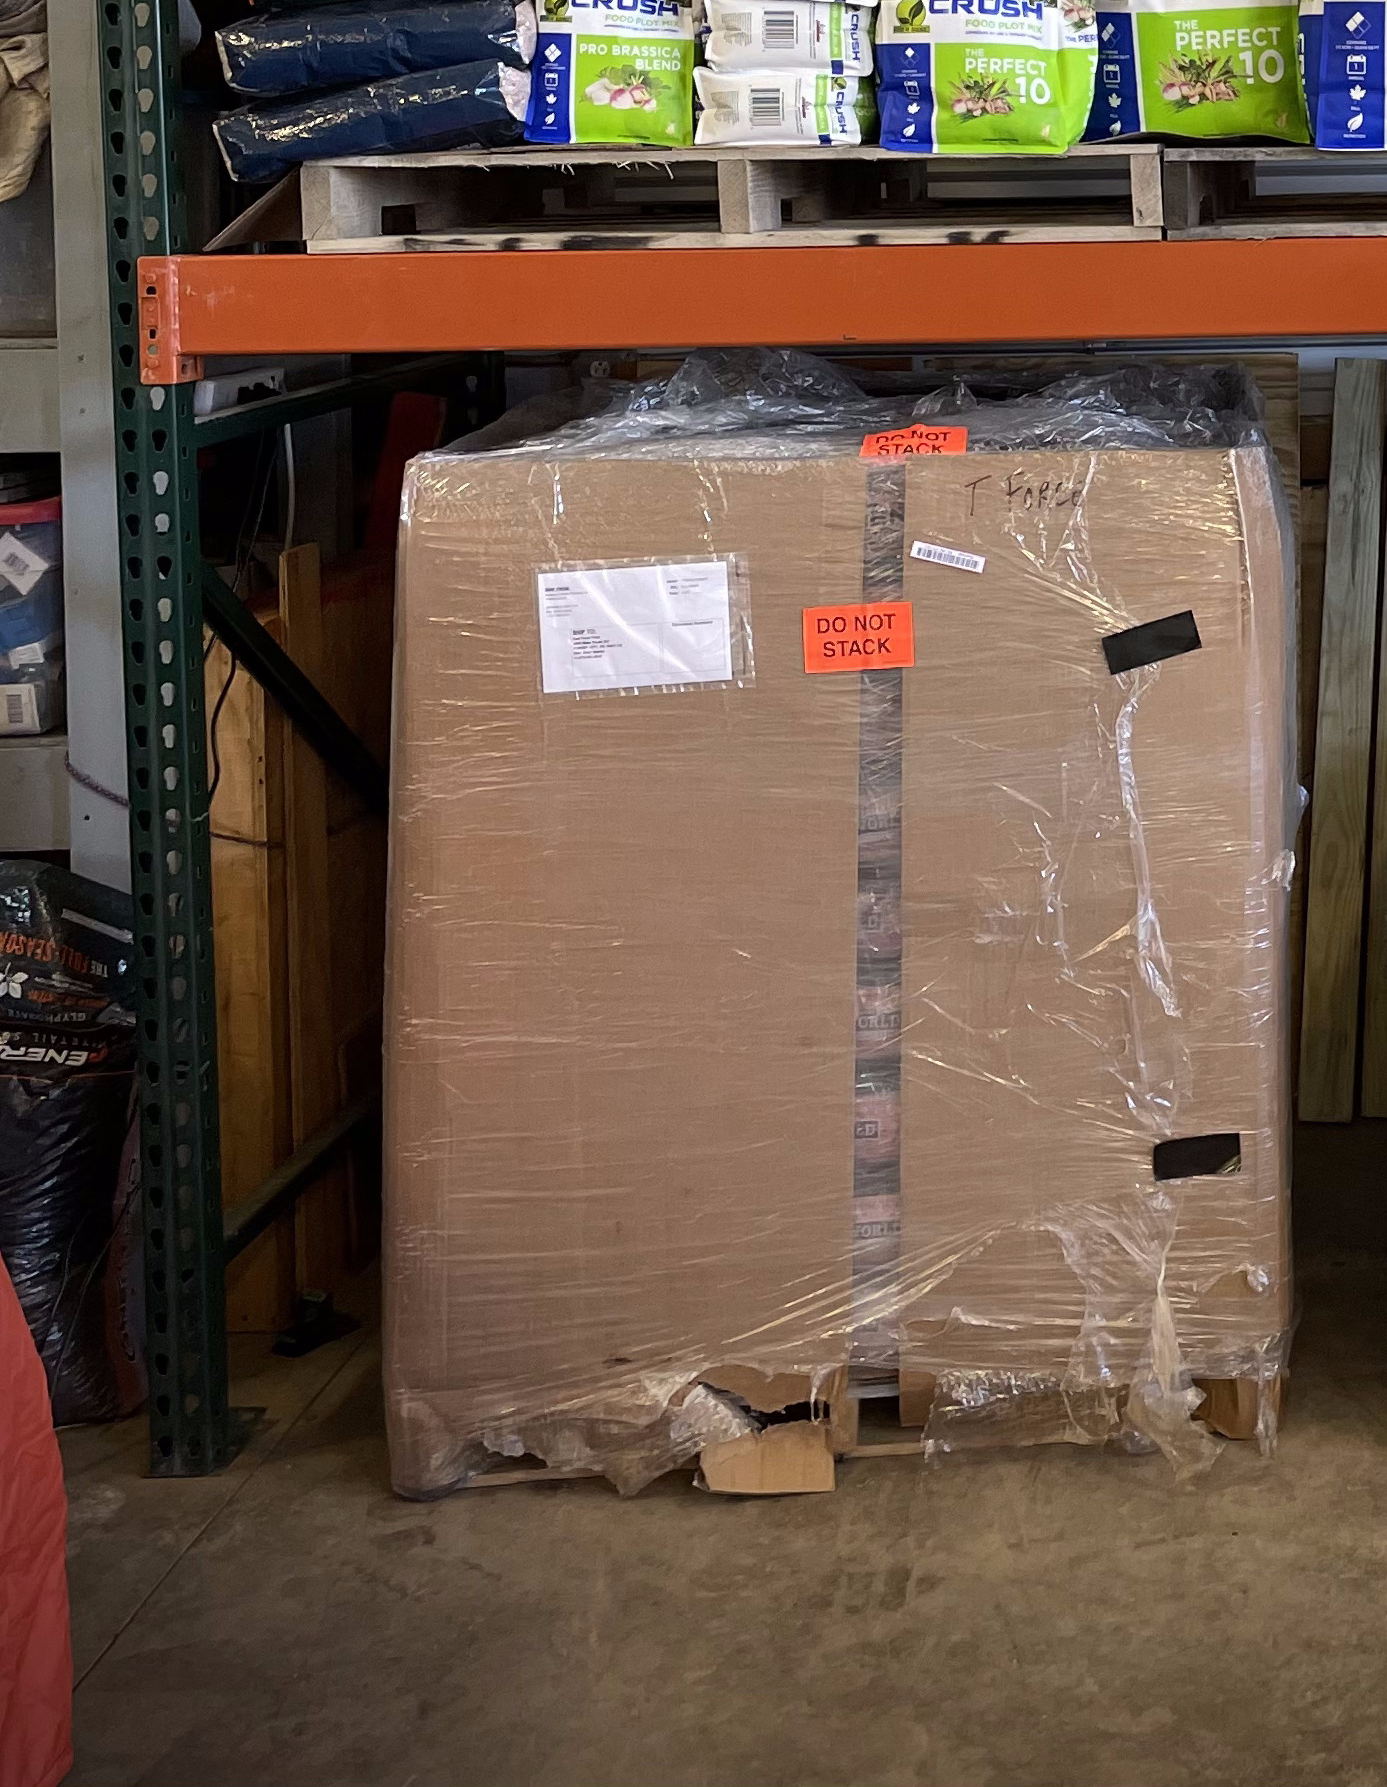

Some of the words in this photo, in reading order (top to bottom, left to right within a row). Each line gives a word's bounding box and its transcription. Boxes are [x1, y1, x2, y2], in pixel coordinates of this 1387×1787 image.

[604, 13, 635, 24] FOOD
[635, 17, 660, 27] PLOT
[662, 19, 680, 28] MIX
[965, 19, 996, 29] FOOD
[999, 20, 1024, 31] PLOT
[1027, 24, 1043, 34] MIX
[1174, 20, 1198, 31] THE
[850, 13, 861, 61] CRUSH
[1175, 27, 1281, 51] PERFECT
[579, 43, 608, 56] PRO
[611, 44, 681, 59] BRASSICA
[965, 48, 985, 58] THE
[635, 58, 681, 71] BLEND
[965, 57, 1048, 77] PERFECT
[1238, 49, 1285, 85] 10
[1015, 76, 1051, 105] 10
[835, 91, 848, 134] CRUSH
[910, 430, 951, 442] NOT
[877, 442, 943, 456] STACK
[816, 616, 847, 634] DO
[854, 613, 897, 631] NOT
[822, 637, 892, 658] STACK
[90, 960, 109, 978] THE
